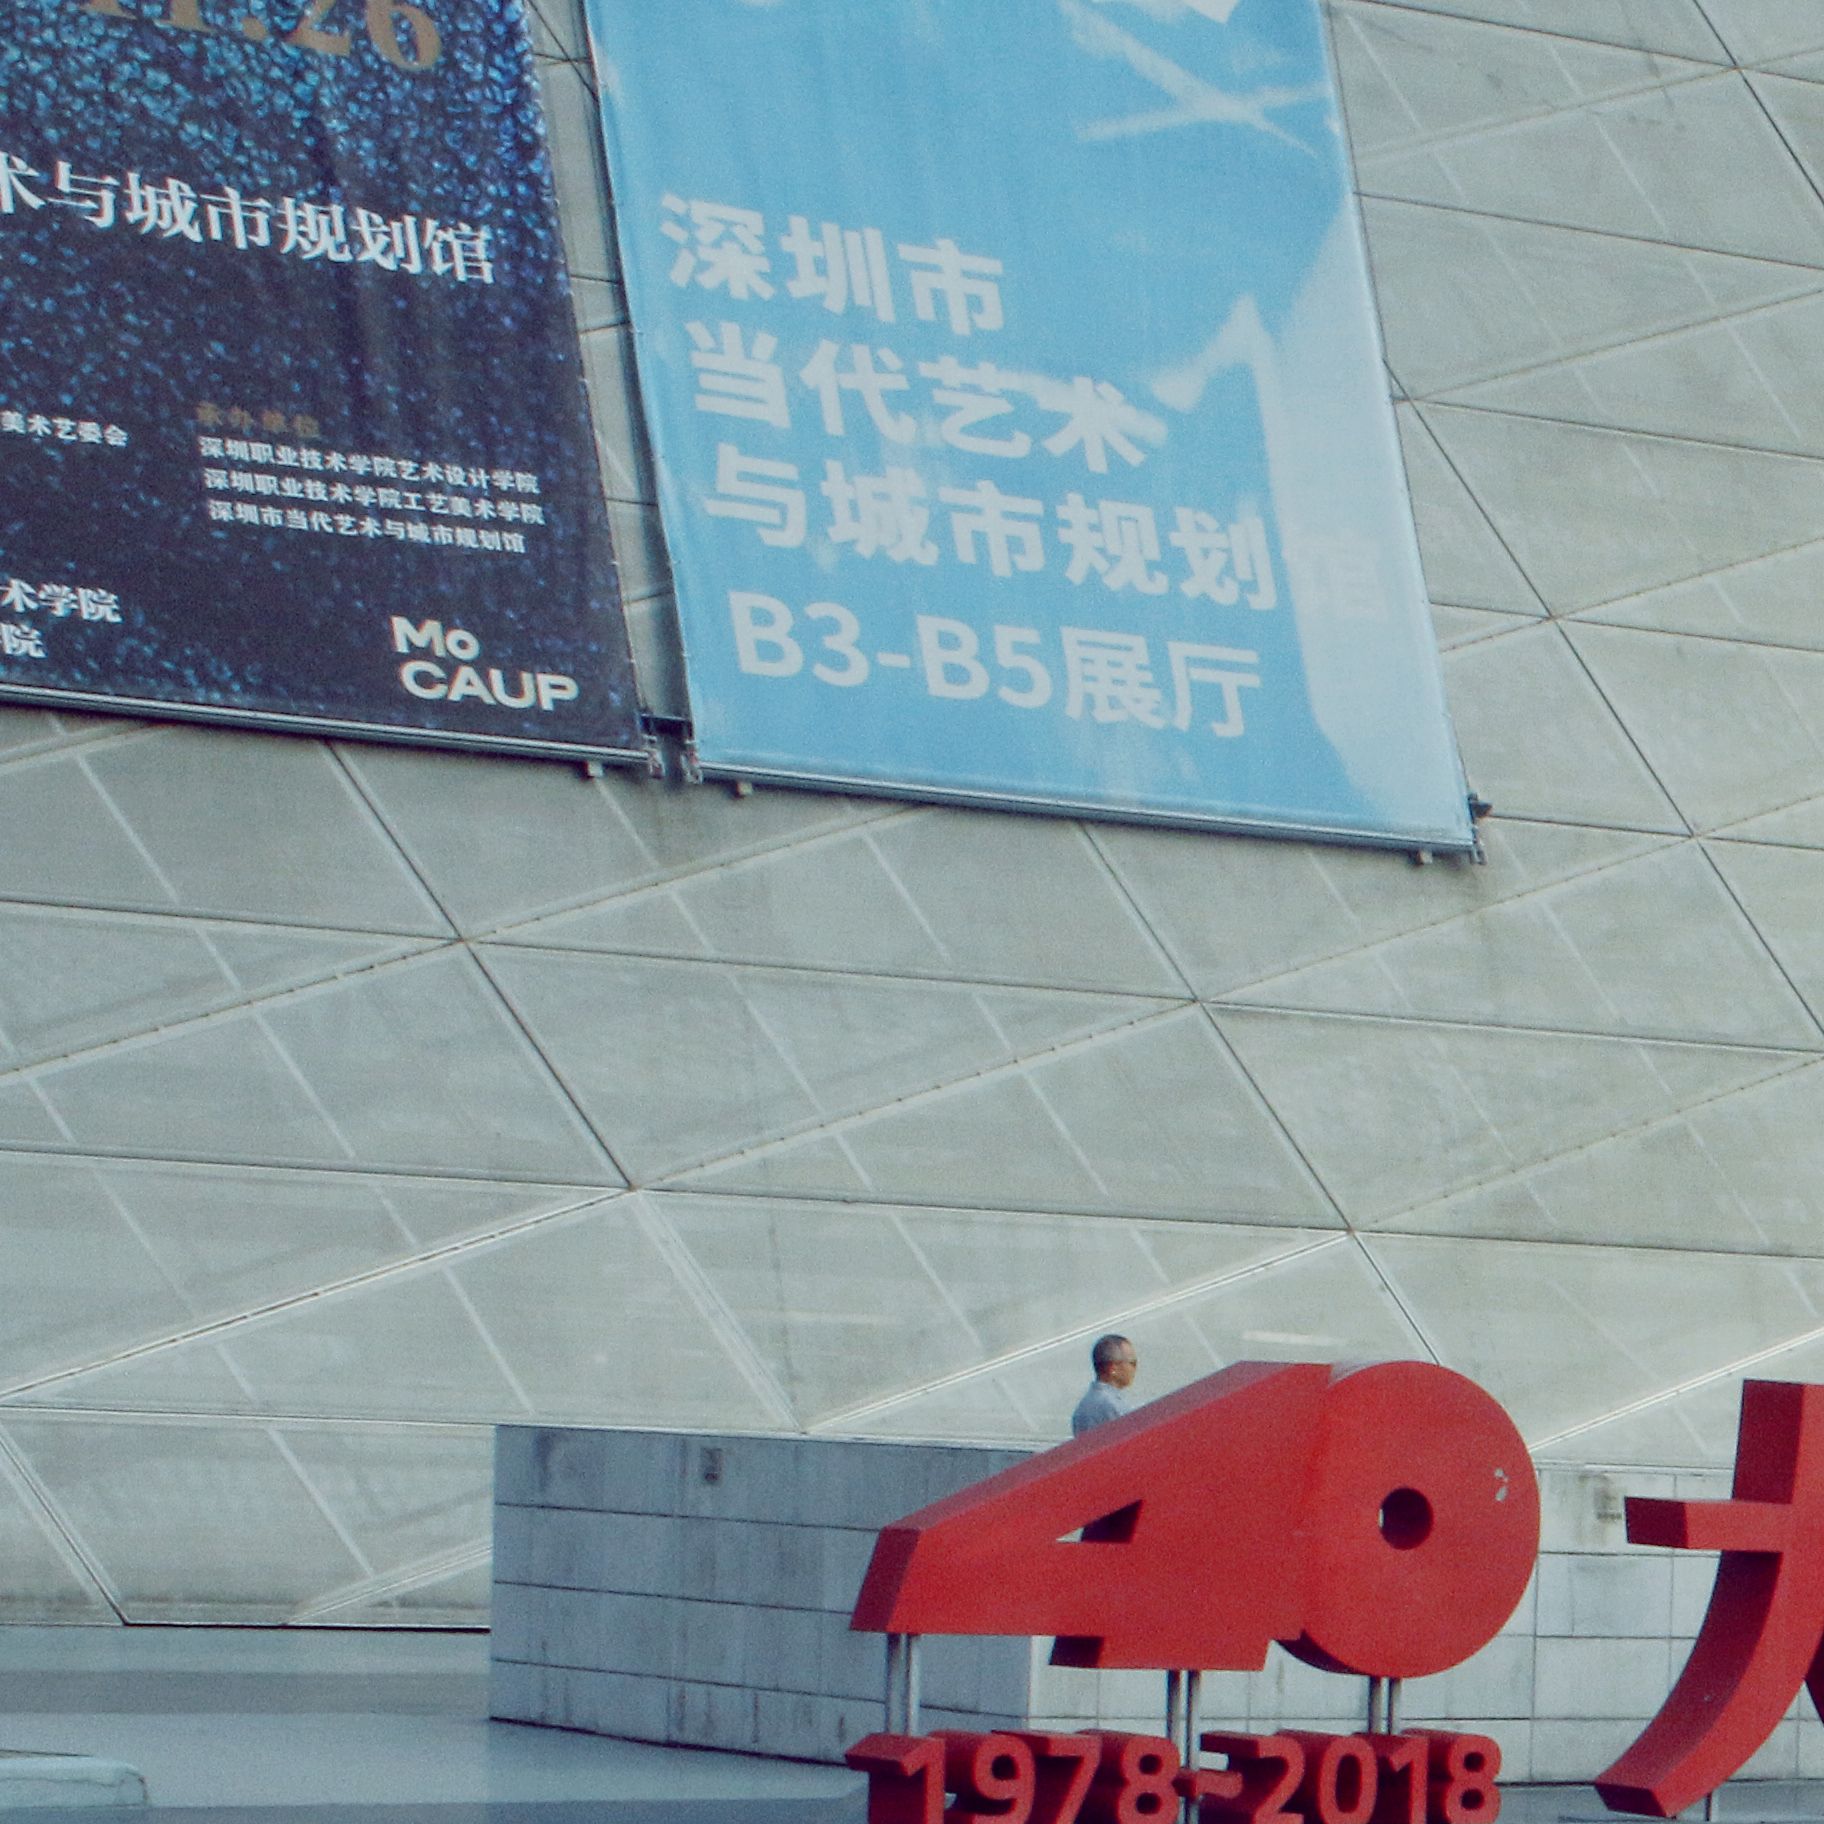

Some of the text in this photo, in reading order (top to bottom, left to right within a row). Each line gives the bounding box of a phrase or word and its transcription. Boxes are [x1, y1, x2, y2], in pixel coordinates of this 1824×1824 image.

[659, 191, 1003, 338] 深圳市
[687, 319, 1168, 475] 当代艺术
[207, 499, 527, 553] 深圳市当代艺术与城市规划馆
[401, 662, 579, 711] CAUP
[728, 591, 1262, 738] B3-B5展厅
[850, 1360, 1542, 1678] 40
